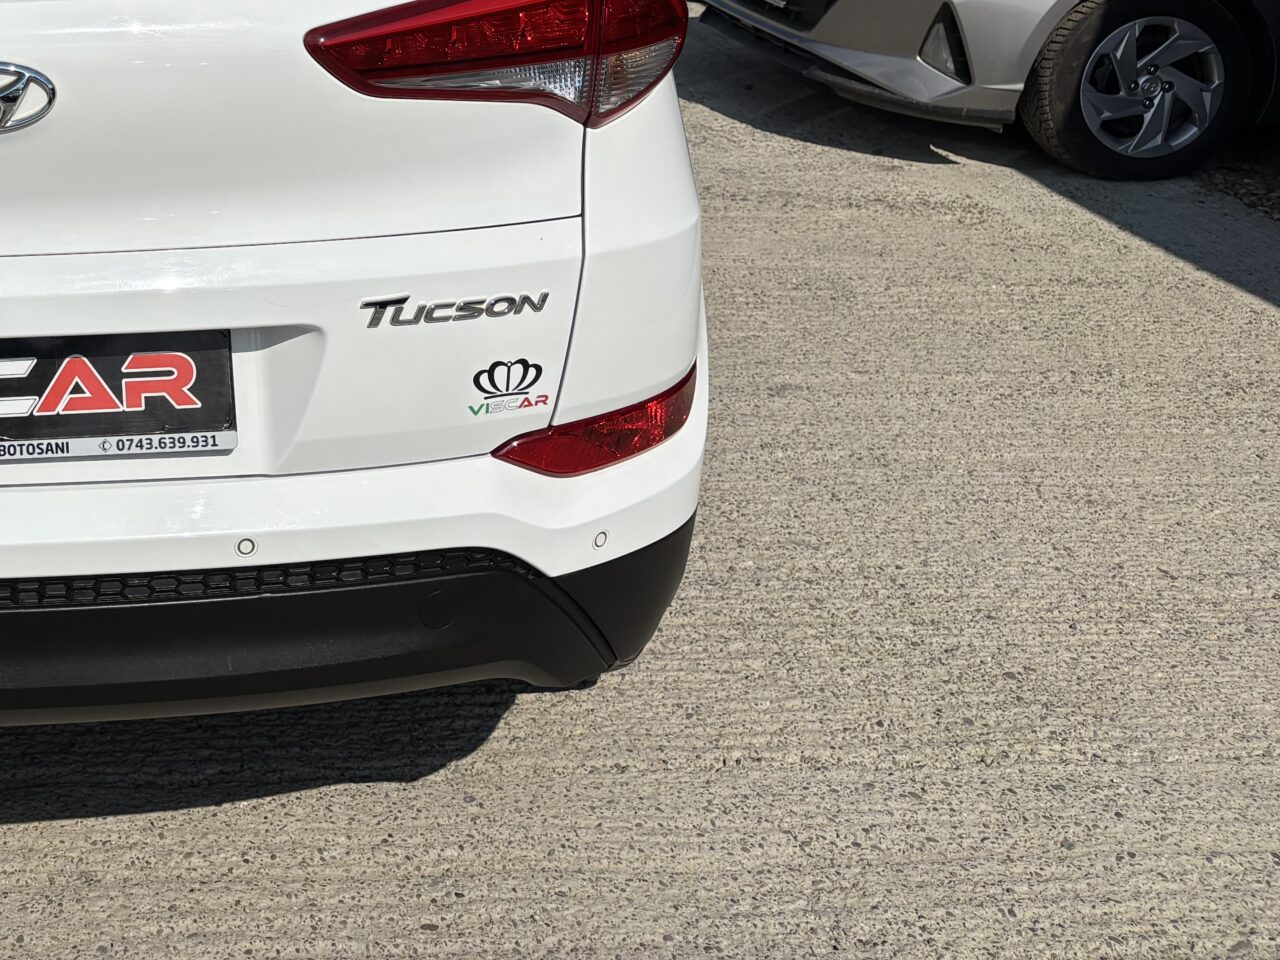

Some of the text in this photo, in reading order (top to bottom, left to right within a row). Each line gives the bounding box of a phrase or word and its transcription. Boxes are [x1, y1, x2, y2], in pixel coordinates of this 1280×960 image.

[360, 291, 550, 329] TUCSON
[467, 394, 549, 416] VISCAR
[116, 434, 219, 452] 0743.639.931
